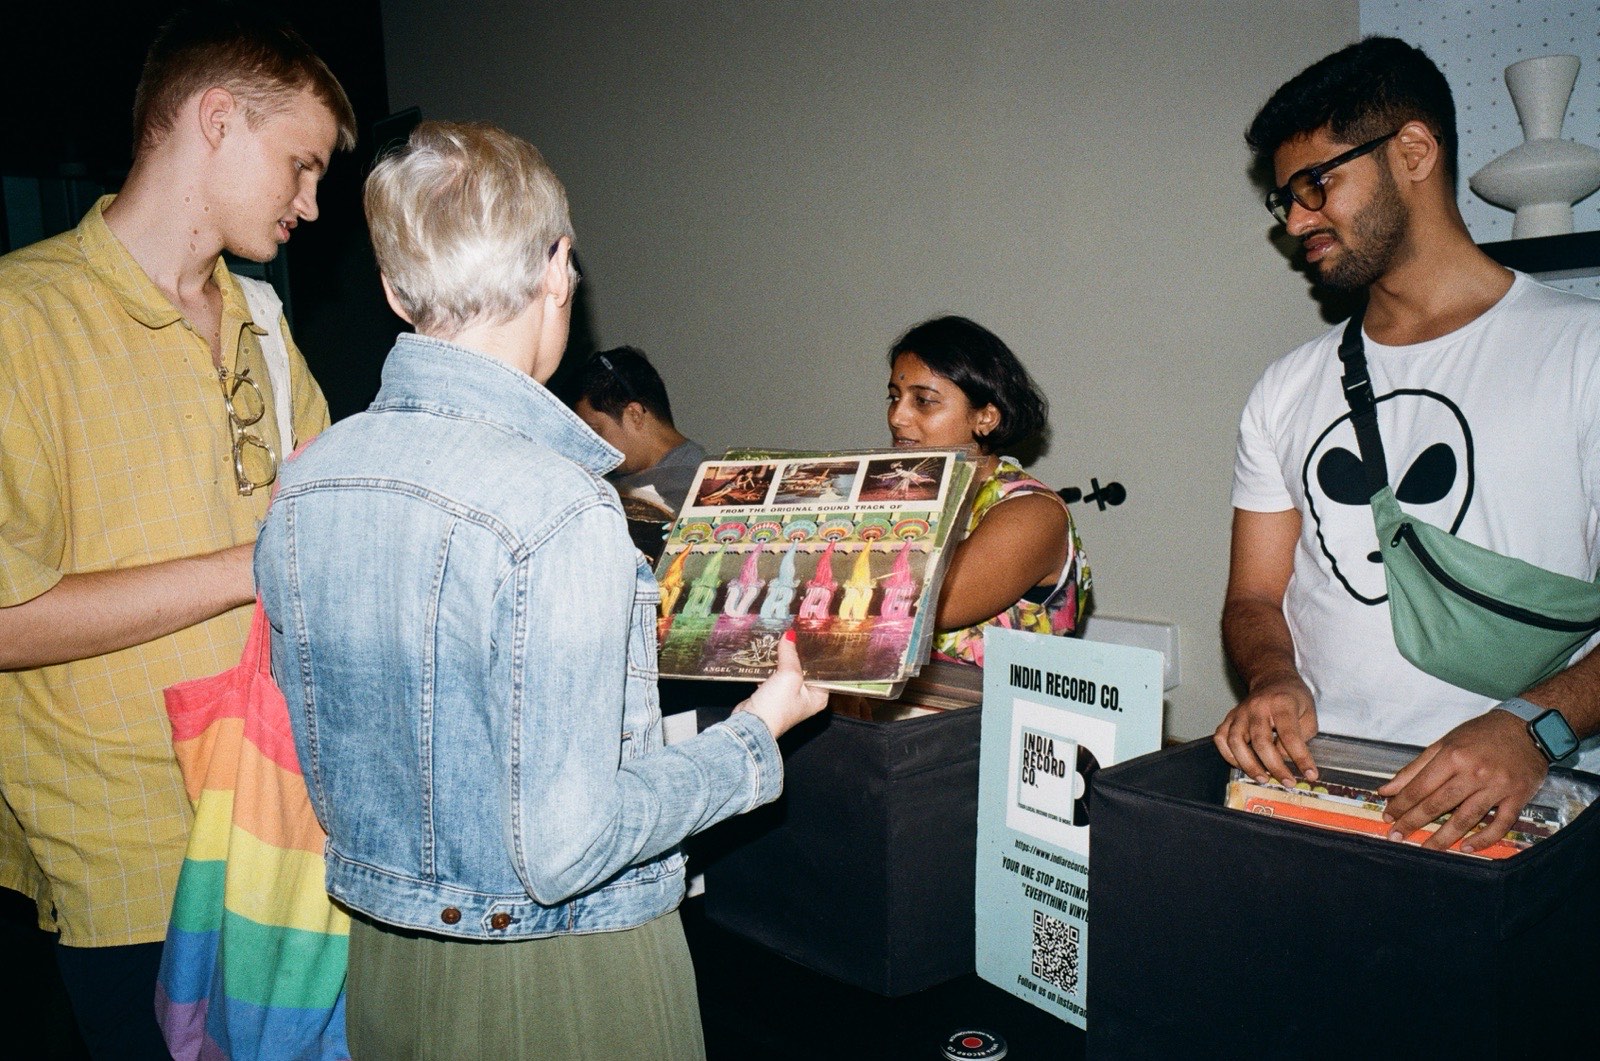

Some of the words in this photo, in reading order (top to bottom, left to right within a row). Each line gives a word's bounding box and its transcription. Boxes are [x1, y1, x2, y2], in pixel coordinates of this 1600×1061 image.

[1009, 664, 1042, 693] INDIA
[1045, 671, 1096, 706] RECORD
[1101, 684, 1123, 713] CO.
[1023, 732, 1054, 757] INDIA
[1021, 766, 1039, 789] CO.
[1022, 748, 1066, 779] RECORD
[1002, 856, 1020, 874] YOUR
[1020, 864, 1036, 881] ONE
[1035, 870, 1055, 888] STOP
[1014, 839, 1089, 877] https://www.indiarecordc
[1017, 974, 1038, 992] Follow
[1038, 985, 1047, 997] us
[1047, 991, 1057, 1002] on
